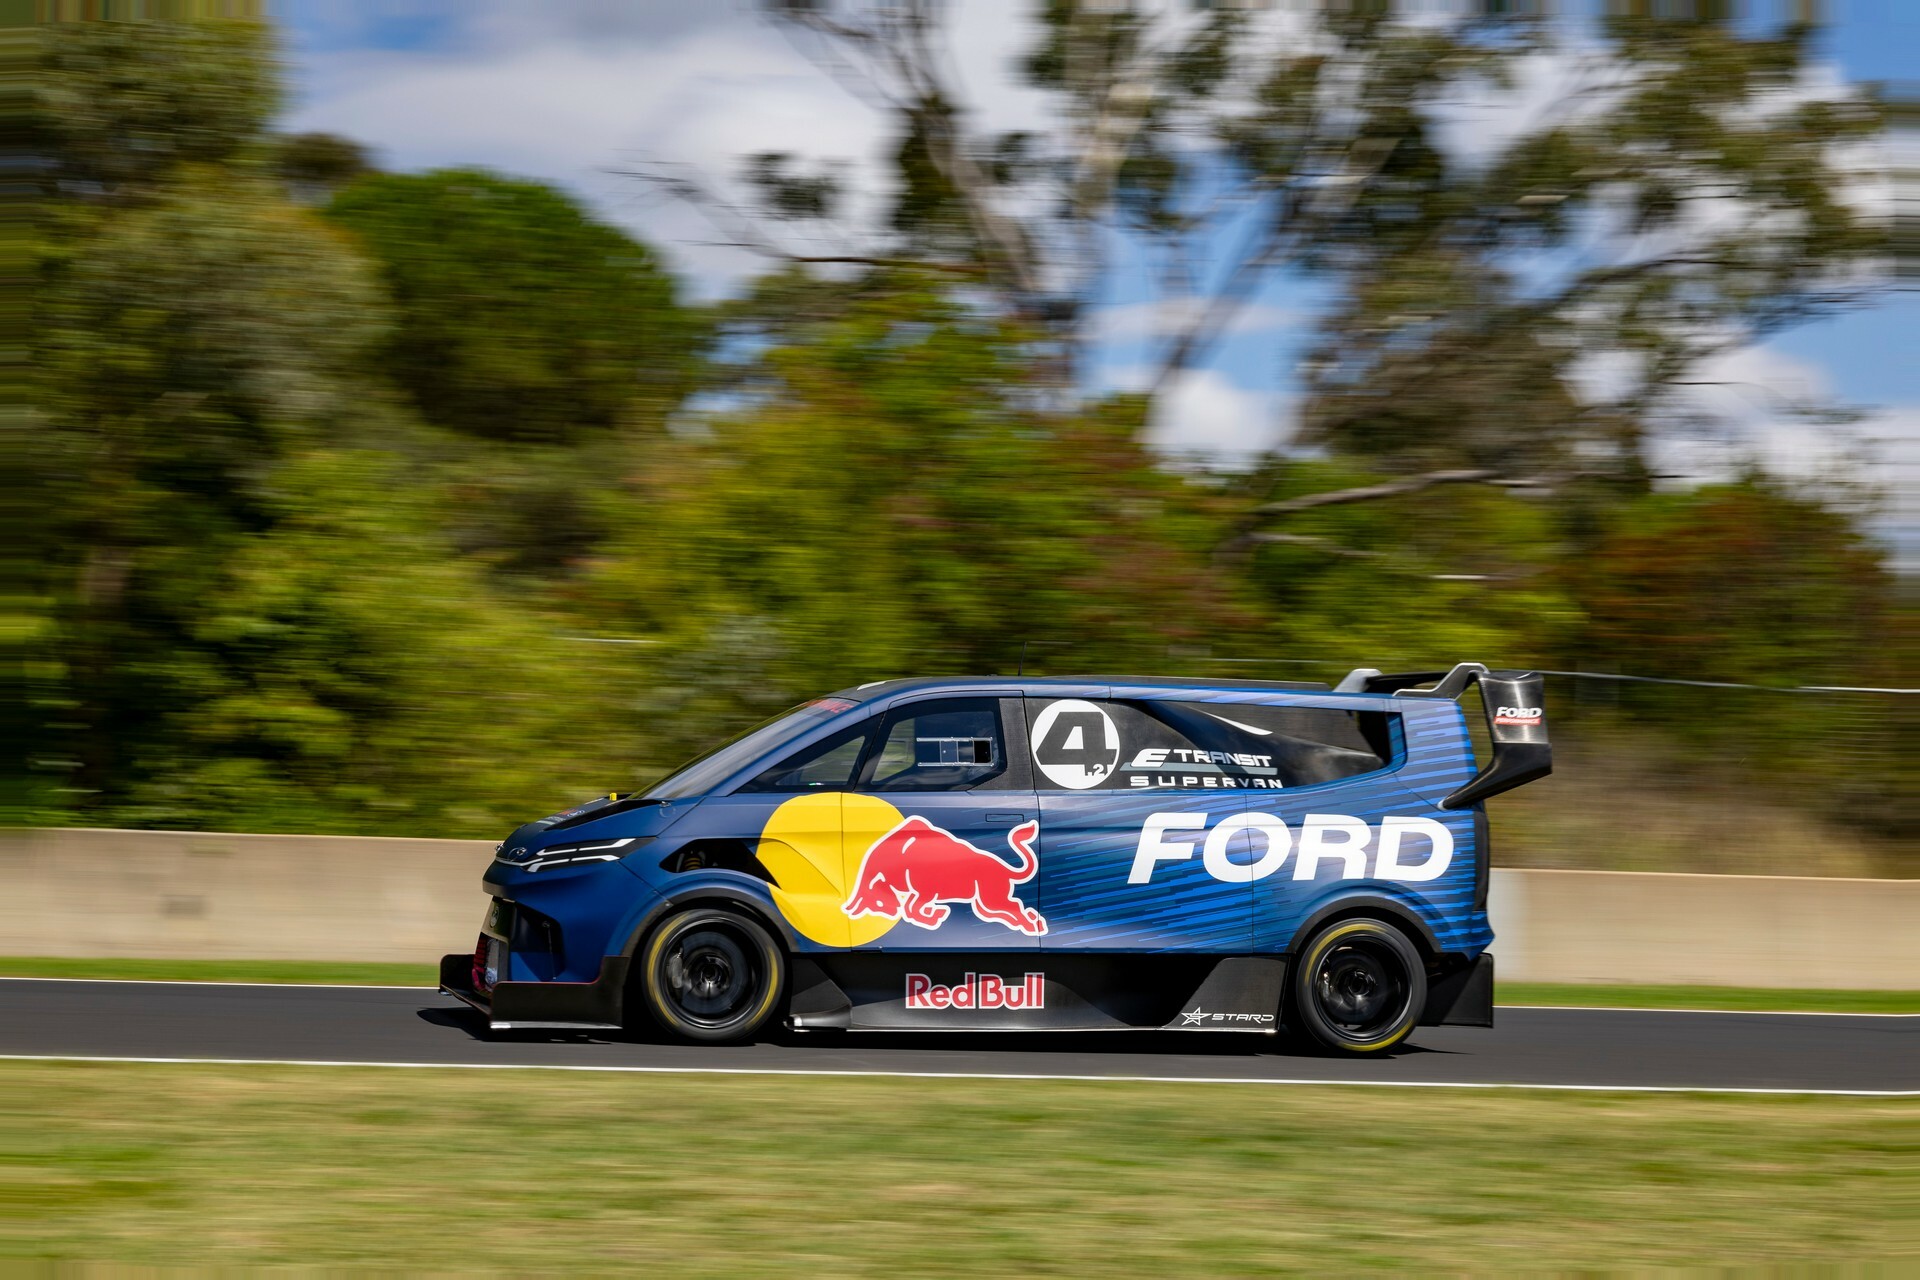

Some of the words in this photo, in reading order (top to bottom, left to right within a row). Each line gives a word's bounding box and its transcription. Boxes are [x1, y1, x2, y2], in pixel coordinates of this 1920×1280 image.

[1496, 706, 1543, 718] FORD
[1130, 775, 1283, 789] SUPERVAN
[1127, 812, 1454, 884] FORD
[906, 972, 976, 1009] Red
[978, 971, 1045, 1010] Bull
[1211, 1013, 1275, 1024] STARD
